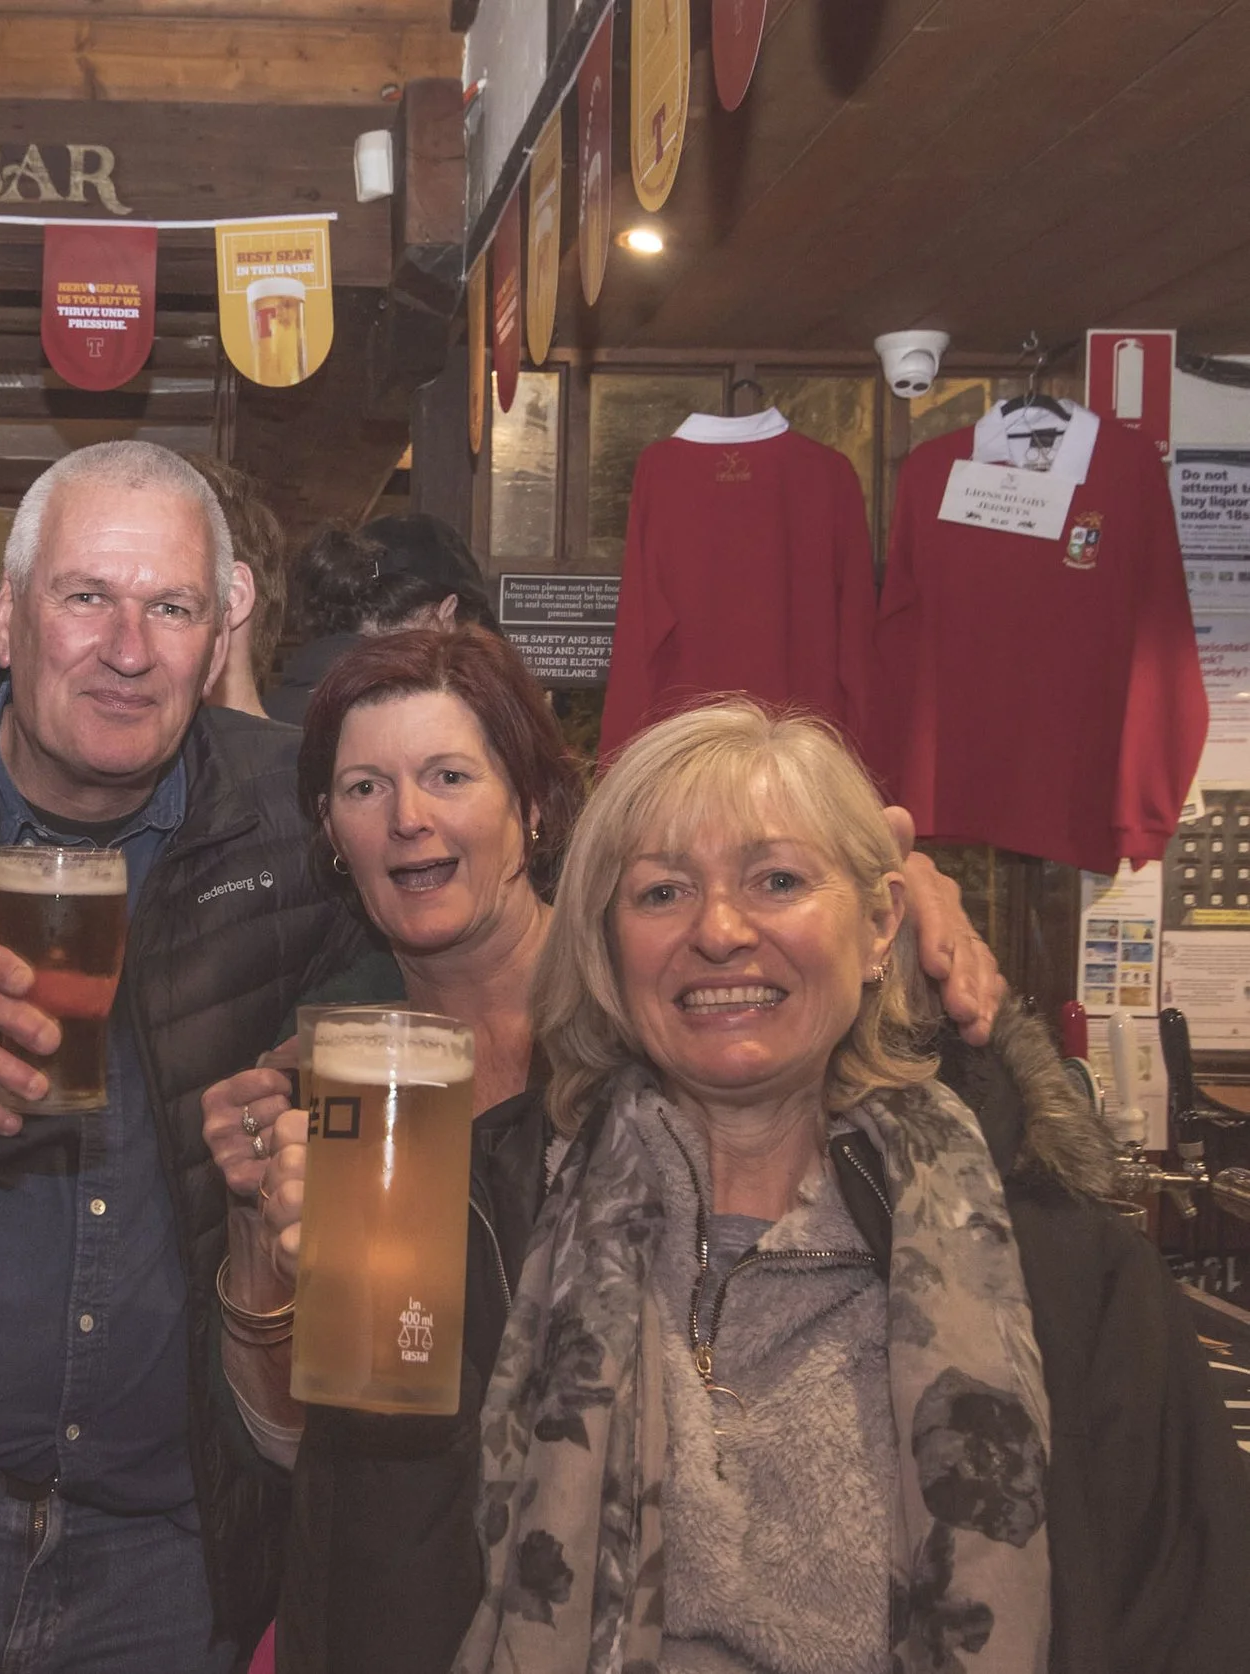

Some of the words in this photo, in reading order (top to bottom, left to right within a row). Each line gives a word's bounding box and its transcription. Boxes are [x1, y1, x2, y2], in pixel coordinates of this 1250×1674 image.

[237, 252, 273, 263] BEST
[276, 249, 313, 261] SEAT
[236, 265, 249, 276] IN
[251, 264, 274, 275] THE
[57, 294, 71, 304] US
[99, 296, 122, 306] BUT
[122, 296, 142, 306] WE
[57, 306, 100, 317] THRIVE
[101, 307, 139, 319] UNDER
[68, 318, 128, 330] PRESSURE.
[86, 337, 104, 358] T
[1181, 469, 1201, 480] Do
[1205, 470, 1228, 480] not
[1181, 483, 1238, 495] attempt
[1181, 496, 1207, 508] buy
[1210, 496, 1248, 507] liquor
[1181, 509, 1221, 520] under
[510, 582, 539, 591] Patrons
[542, 582, 566, 593] please
[568, 584, 585, 592] note
[587, 583, 603, 592] that
[505, 591, 524, 600] from
[525, 591, 554, 600] outside
[555, 592, 582, 600] cannot
[584, 592, 594, 600] be
[541, 601, 582, 609] consumed
[595, 602, 616, 610] these
[547, 611, 584, 619] premises
[509, 634, 529, 643] THE
[530, 635, 566, 644] SAFETY
[567, 636, 588, 644] AND
[517, 646, 554, 655] TRONS
[554, 647, 576, 655] AND
[577, 647, 606, 656] STAFF
[534, 658, 567, 666] UNDER
[198, 876, 255, 904] cederberg
[399, 1310, 420, 1325] 400
[421, 1313, 434, 1327] ml
